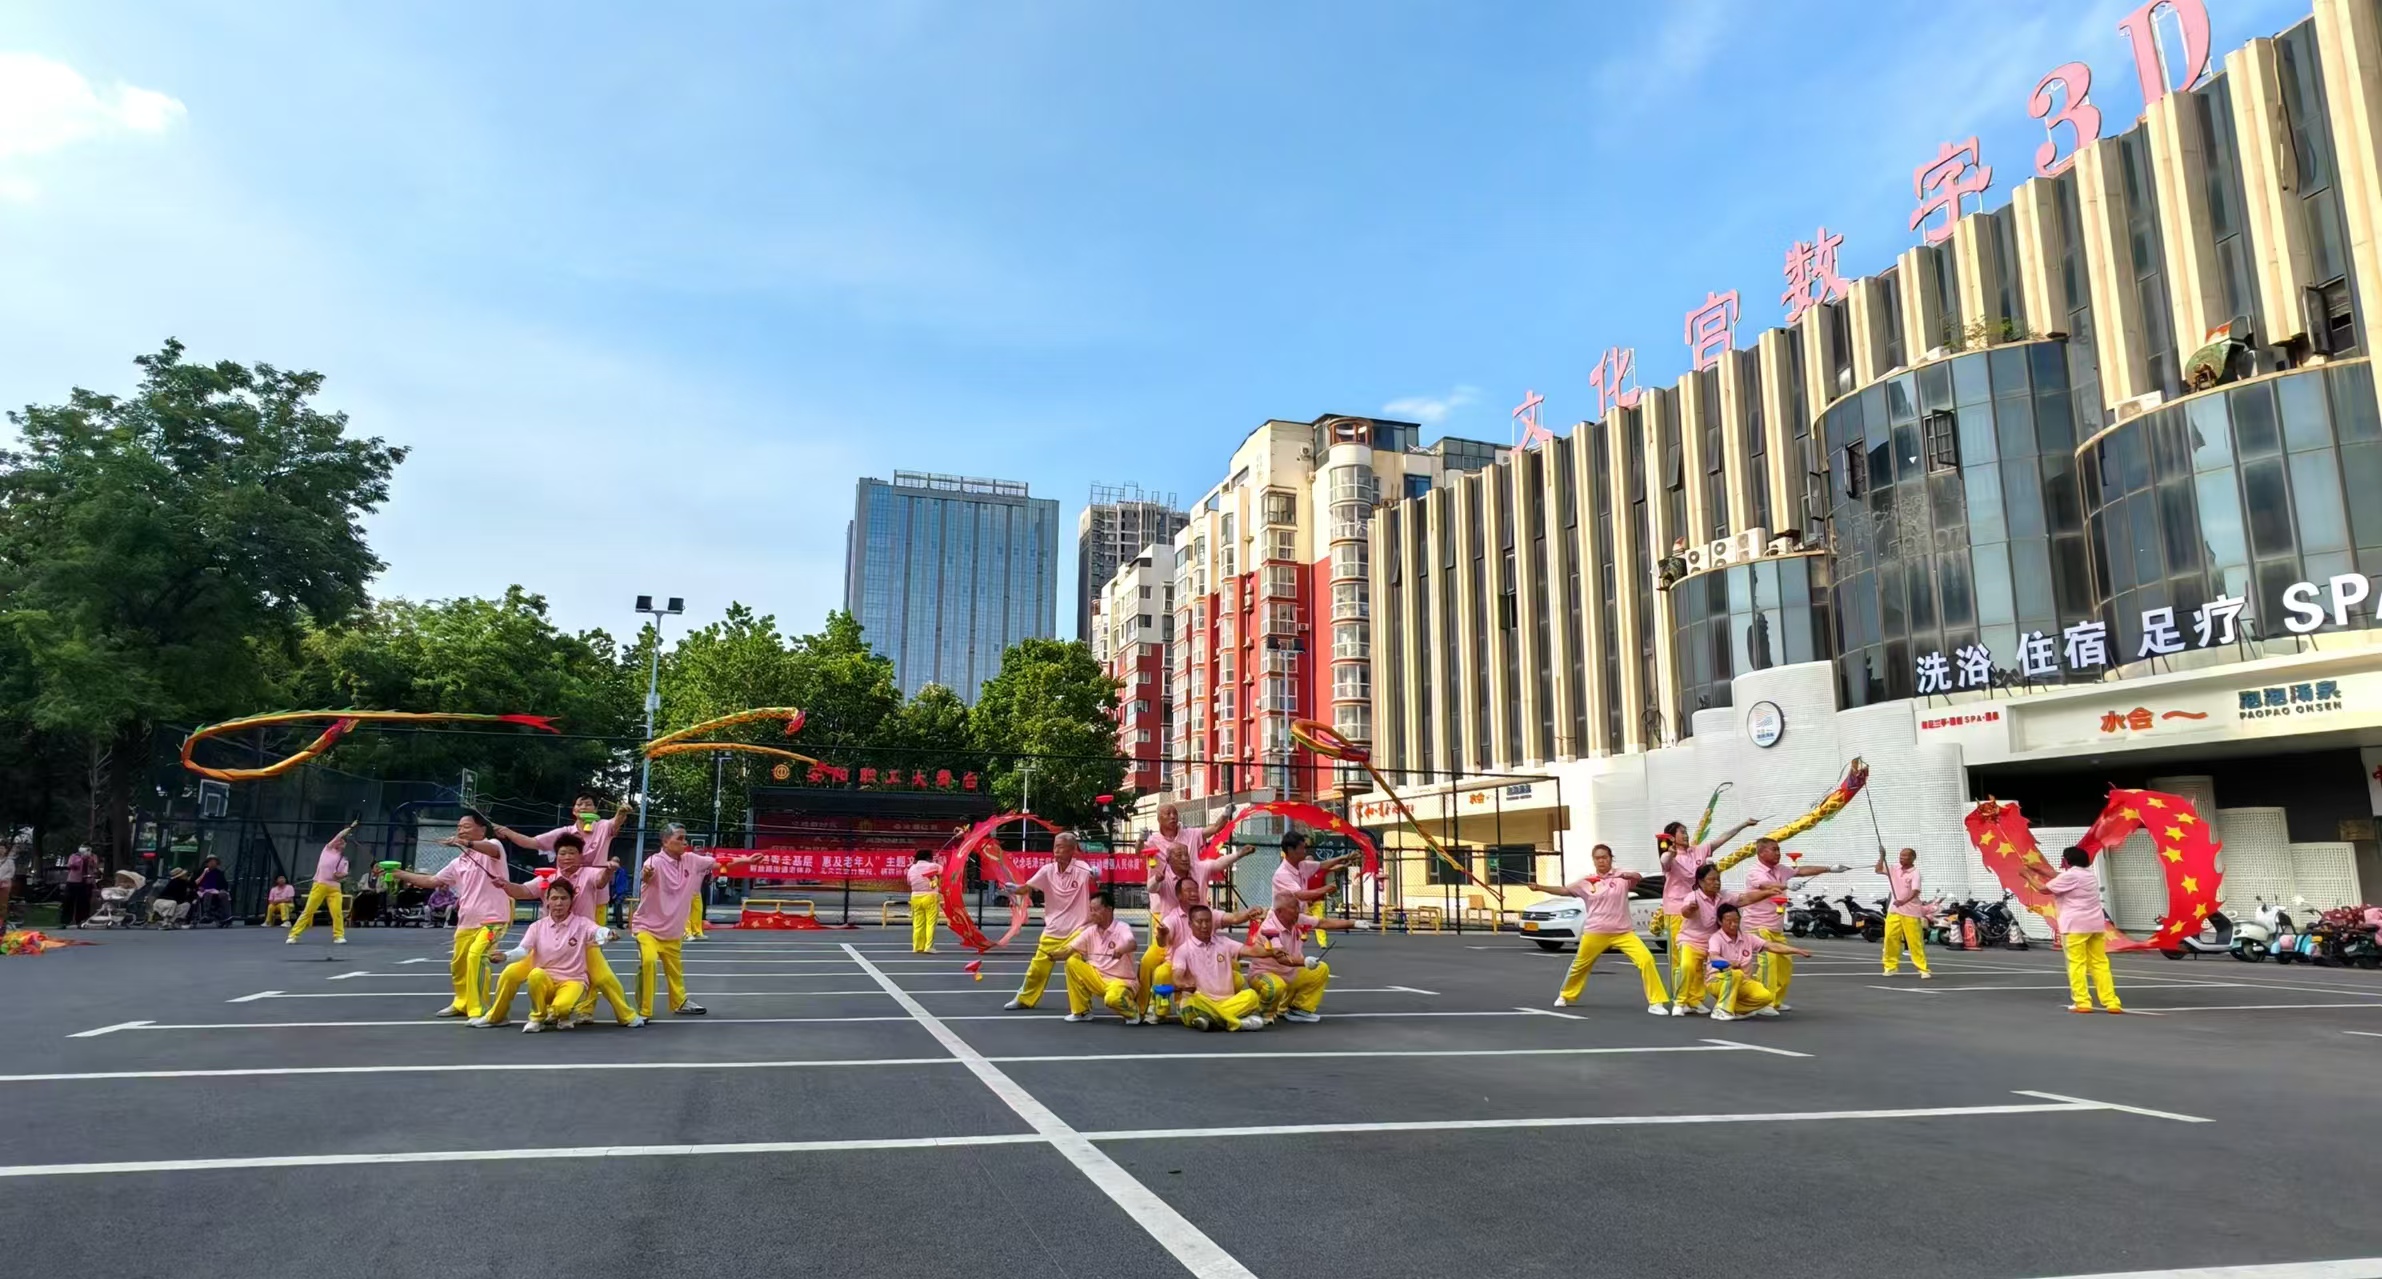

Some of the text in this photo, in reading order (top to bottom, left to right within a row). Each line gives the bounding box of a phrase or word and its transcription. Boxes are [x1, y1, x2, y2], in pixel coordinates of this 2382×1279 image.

[1511, 0, 2212, 454] 文化宫数字3D
[1916, 641, 1992, 695] 洗浴
[2016, 619, 2107, 678] 住宿
[2137, 594, 2246, 658] 足疗
[2239, 701, 2343, 720] PAOPAO ONSEN
